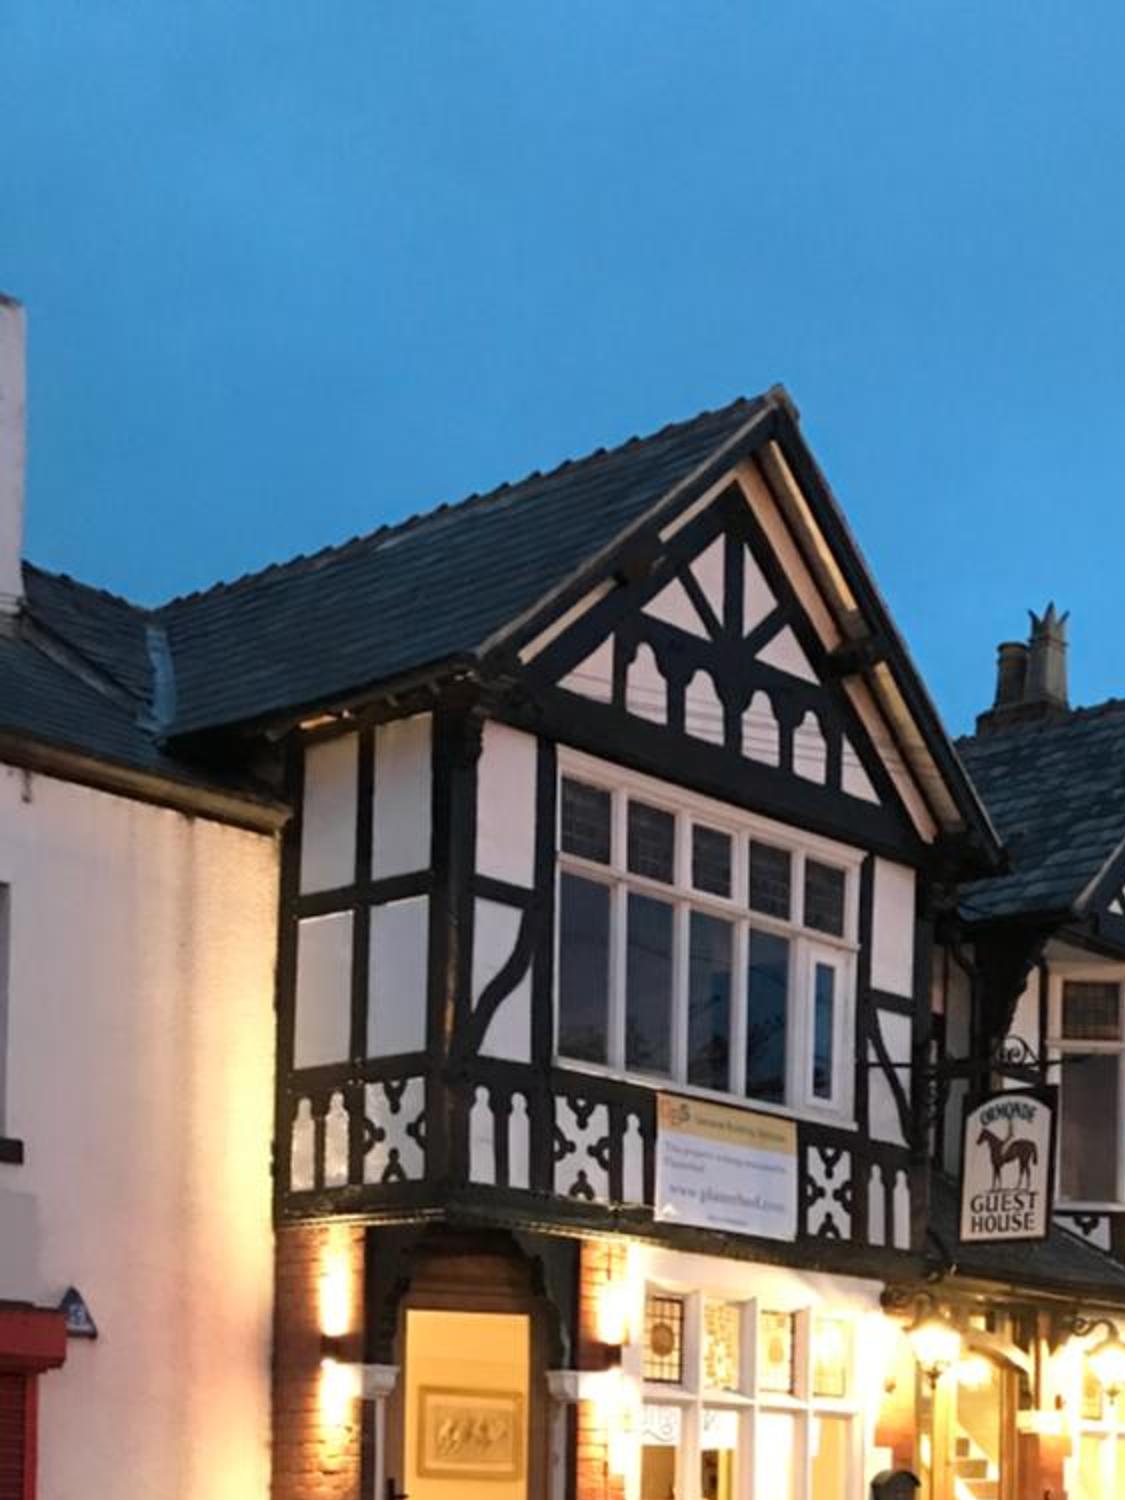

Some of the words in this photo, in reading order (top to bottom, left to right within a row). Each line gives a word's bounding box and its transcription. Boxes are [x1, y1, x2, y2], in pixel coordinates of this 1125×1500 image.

[980, 1101, 1037, 1126] ORMONDE
[970, 1191, 1037, 1214] GUEST
[971, 1212, 1035, 1233] HOUSE
